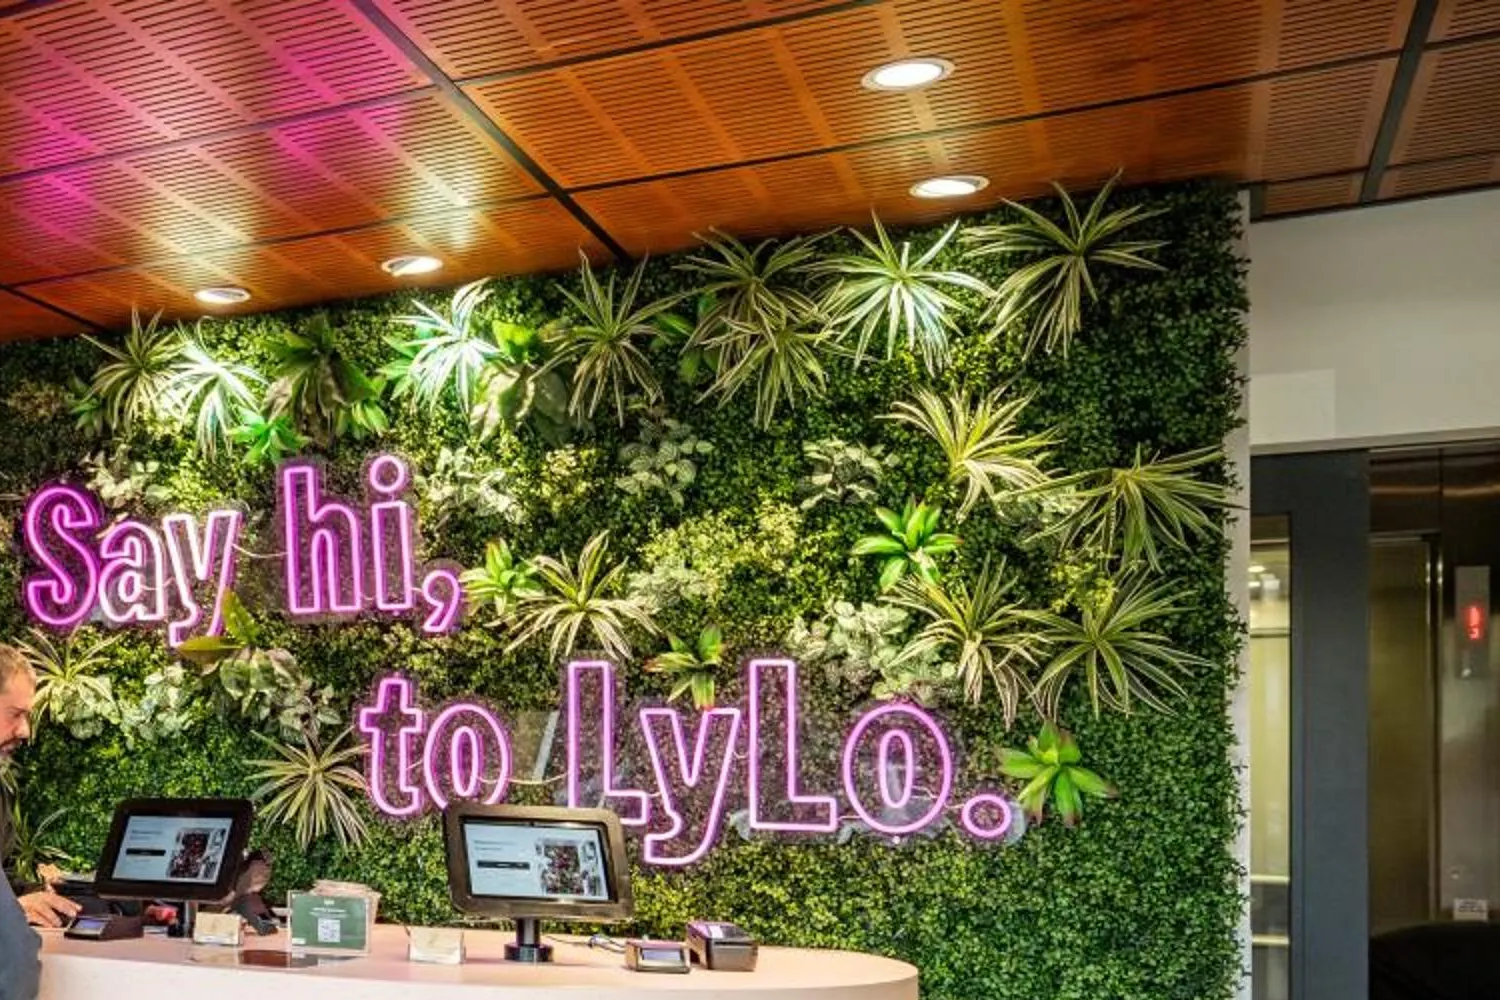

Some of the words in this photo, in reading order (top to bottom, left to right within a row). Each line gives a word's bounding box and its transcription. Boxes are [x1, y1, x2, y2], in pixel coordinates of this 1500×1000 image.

[25, 486, 242, 648] Say
[283, 454, 461, 633] hi,
[360, 677, 511, 817] to
[566, 658, 1012, 866] LyLo.
